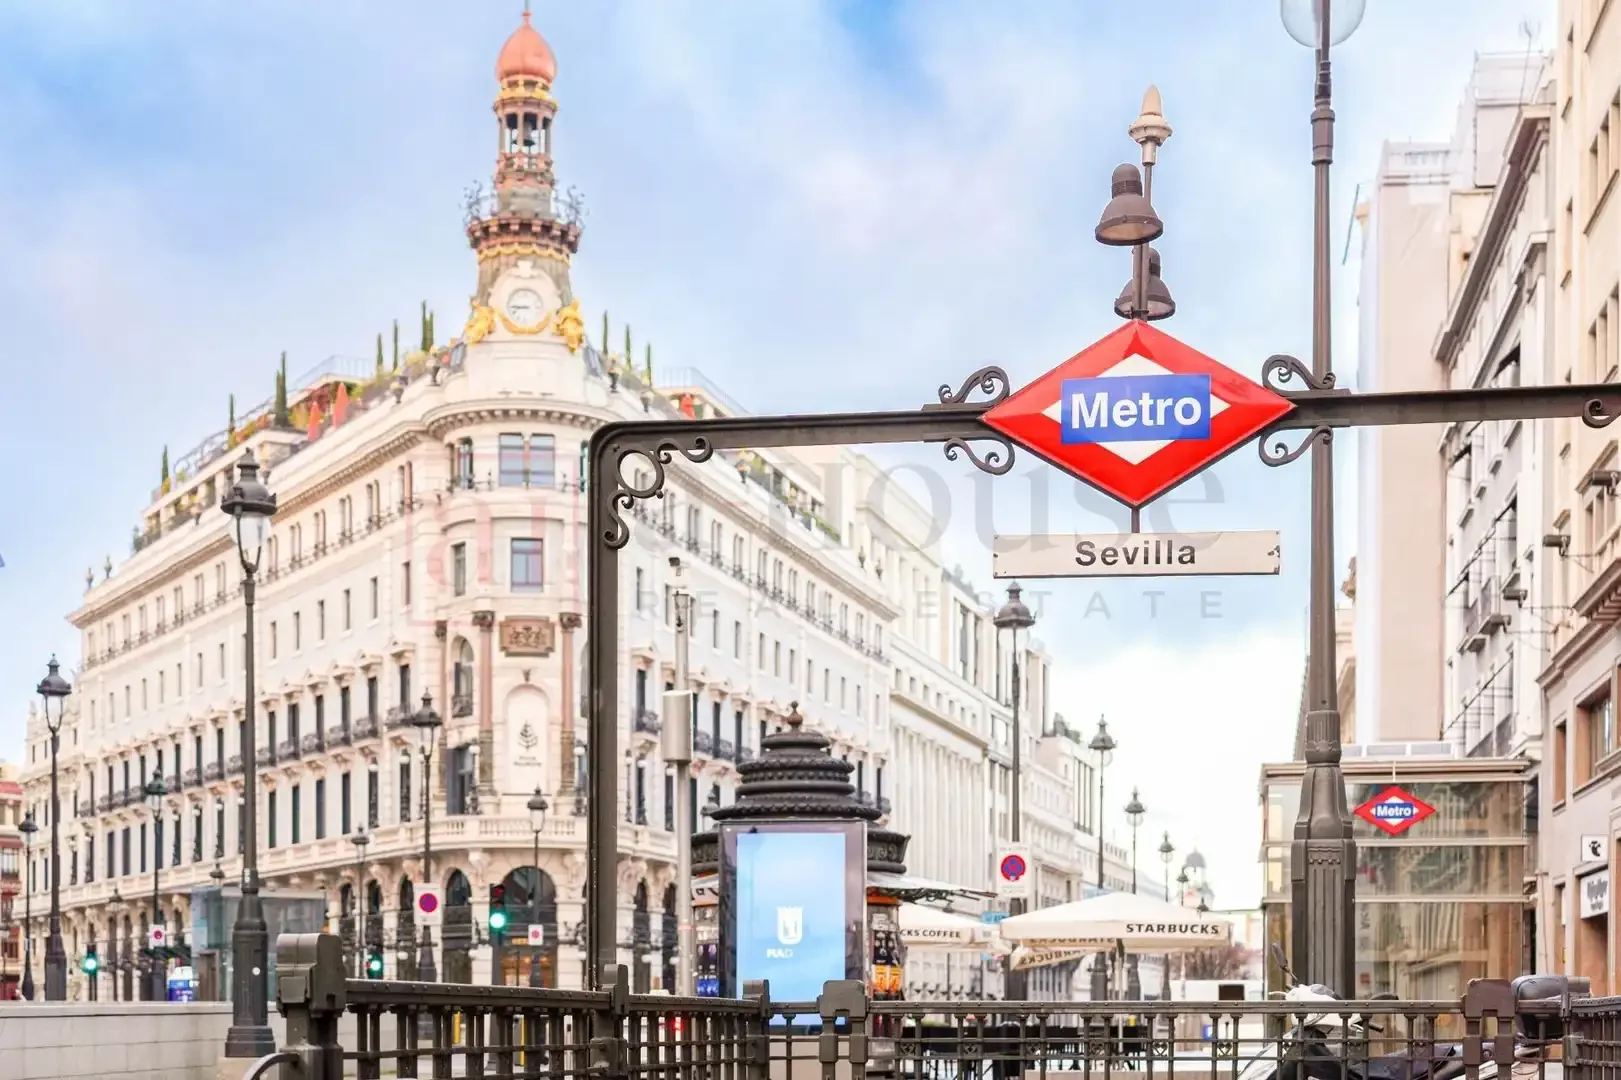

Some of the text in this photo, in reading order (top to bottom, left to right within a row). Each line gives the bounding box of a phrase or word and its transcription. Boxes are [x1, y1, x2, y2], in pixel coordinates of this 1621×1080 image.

[1071, 392, 1202, 429] Metro
[1074, 540, 1196, 567] Sevilla
[1376, 804, 1412, 817] Metro
[922, 928, 961, 938] COFFEE
[1126, 922, 1220, 935] STARBUCKS
